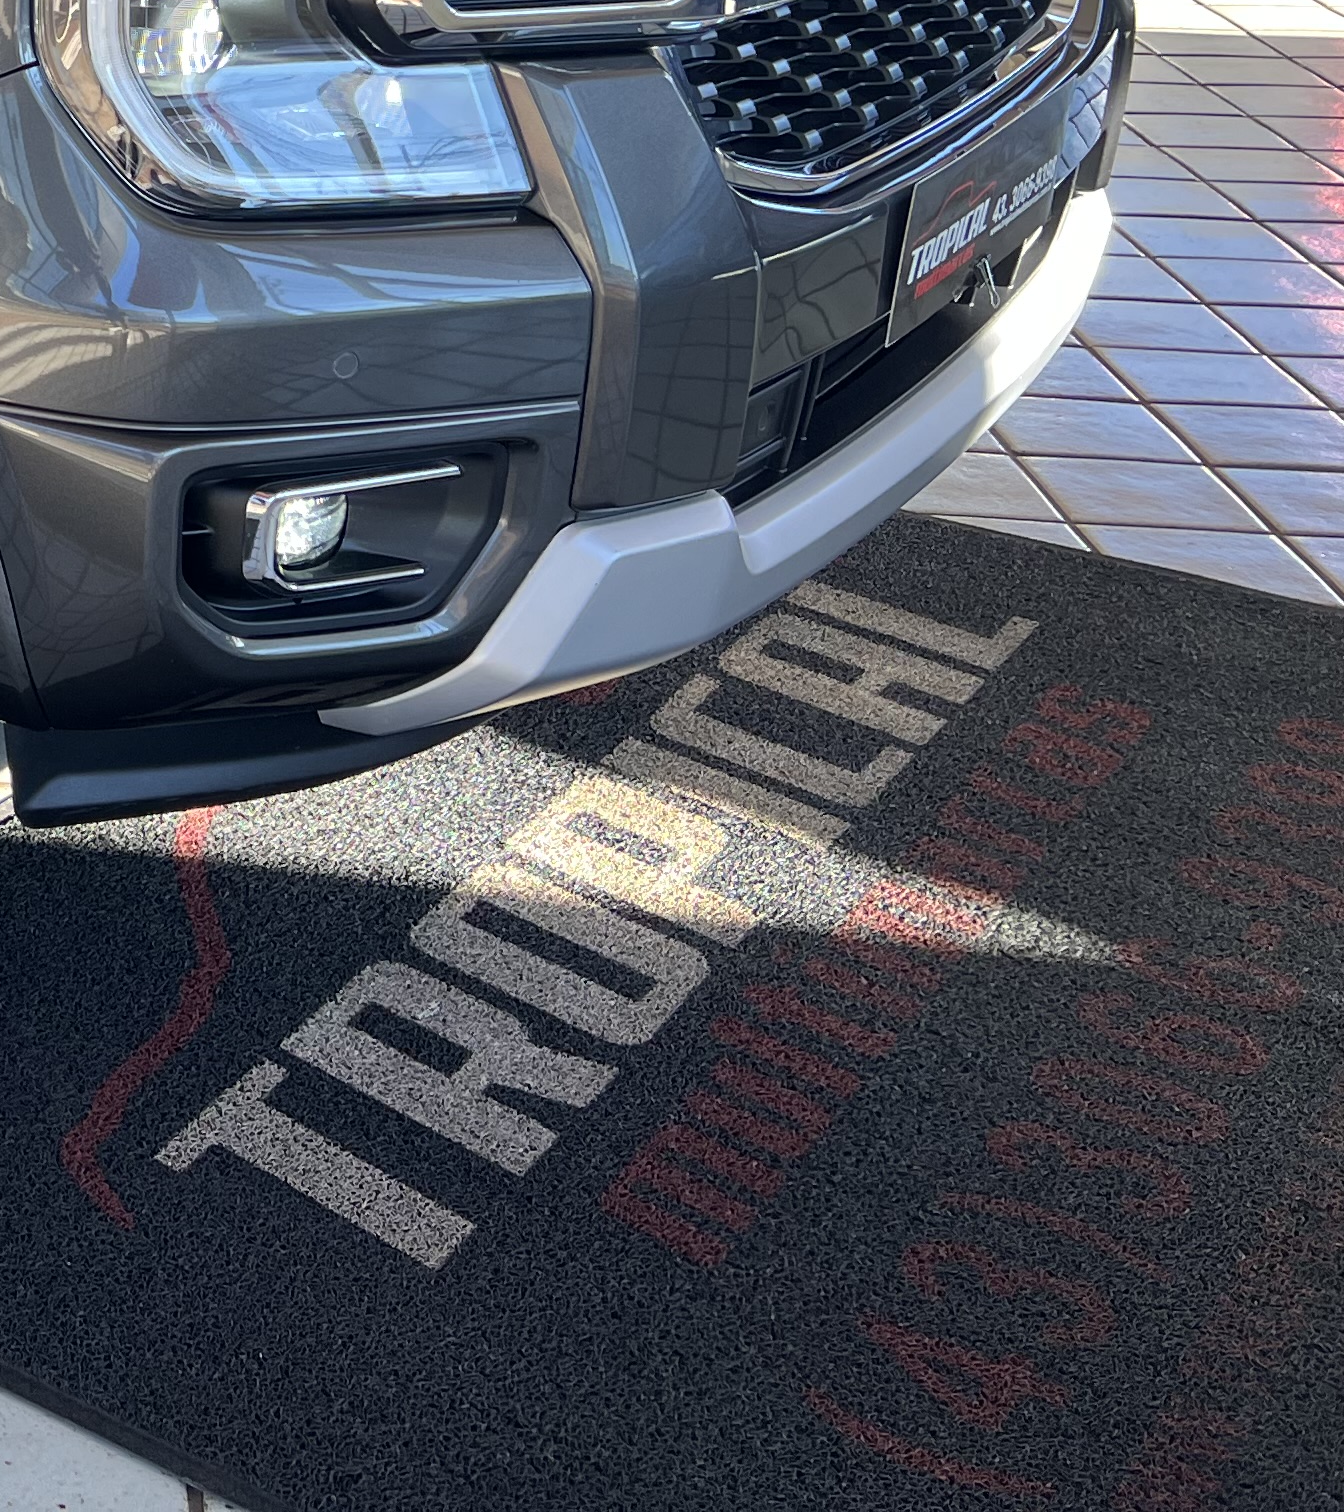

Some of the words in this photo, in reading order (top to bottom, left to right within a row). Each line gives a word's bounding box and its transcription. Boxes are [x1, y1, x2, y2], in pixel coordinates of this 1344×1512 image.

[906, 196, 991, 286] TROPICAL
[153, 579, 1041, 1269] TROPICAL
[600, 682, 1153, 1269] multimarcas
